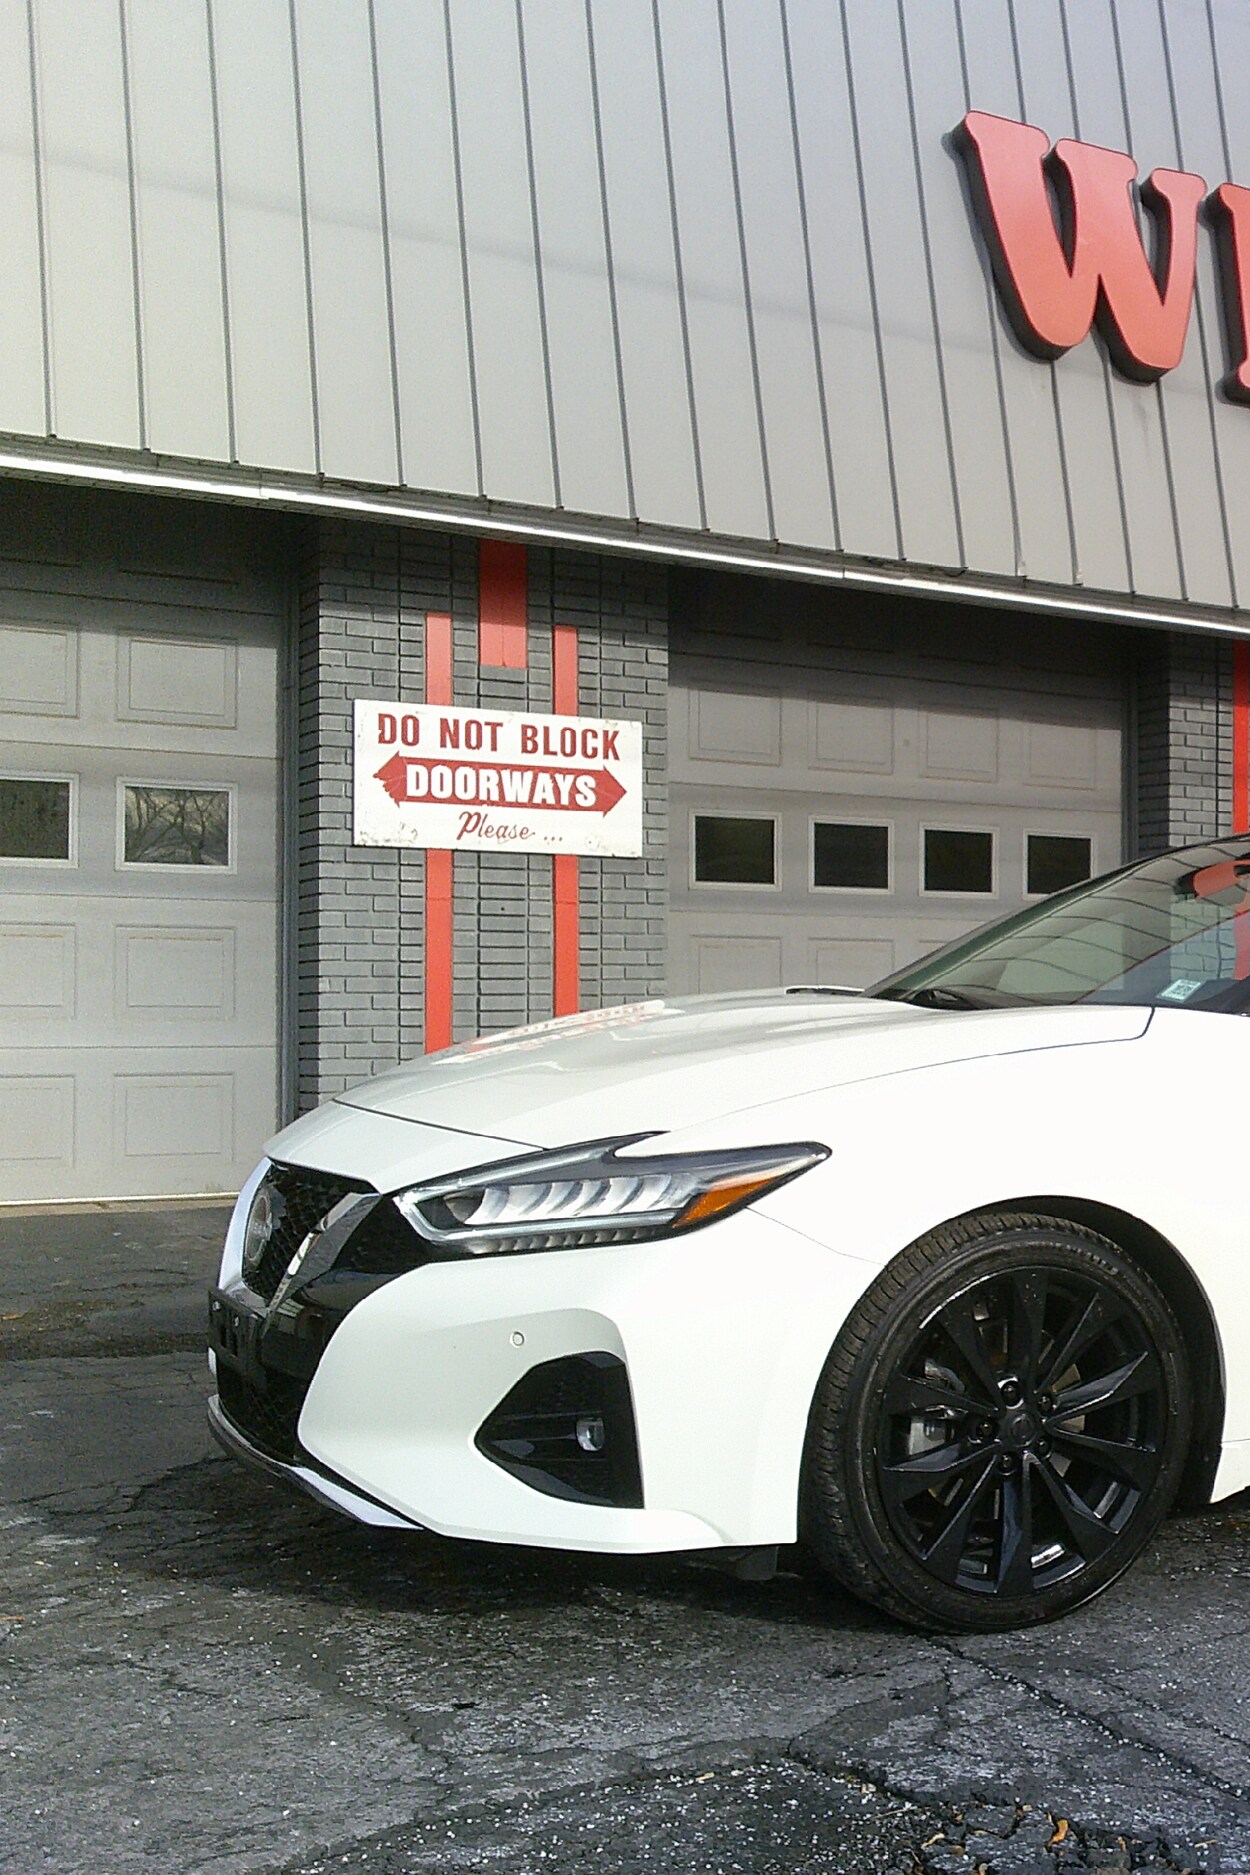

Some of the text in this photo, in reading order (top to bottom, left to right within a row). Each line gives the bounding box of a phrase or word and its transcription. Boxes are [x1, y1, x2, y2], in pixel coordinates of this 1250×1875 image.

[377, 712, 621, 761] DO NOT BLOCK
[405, 764, 597, 808] DOORWAYS
